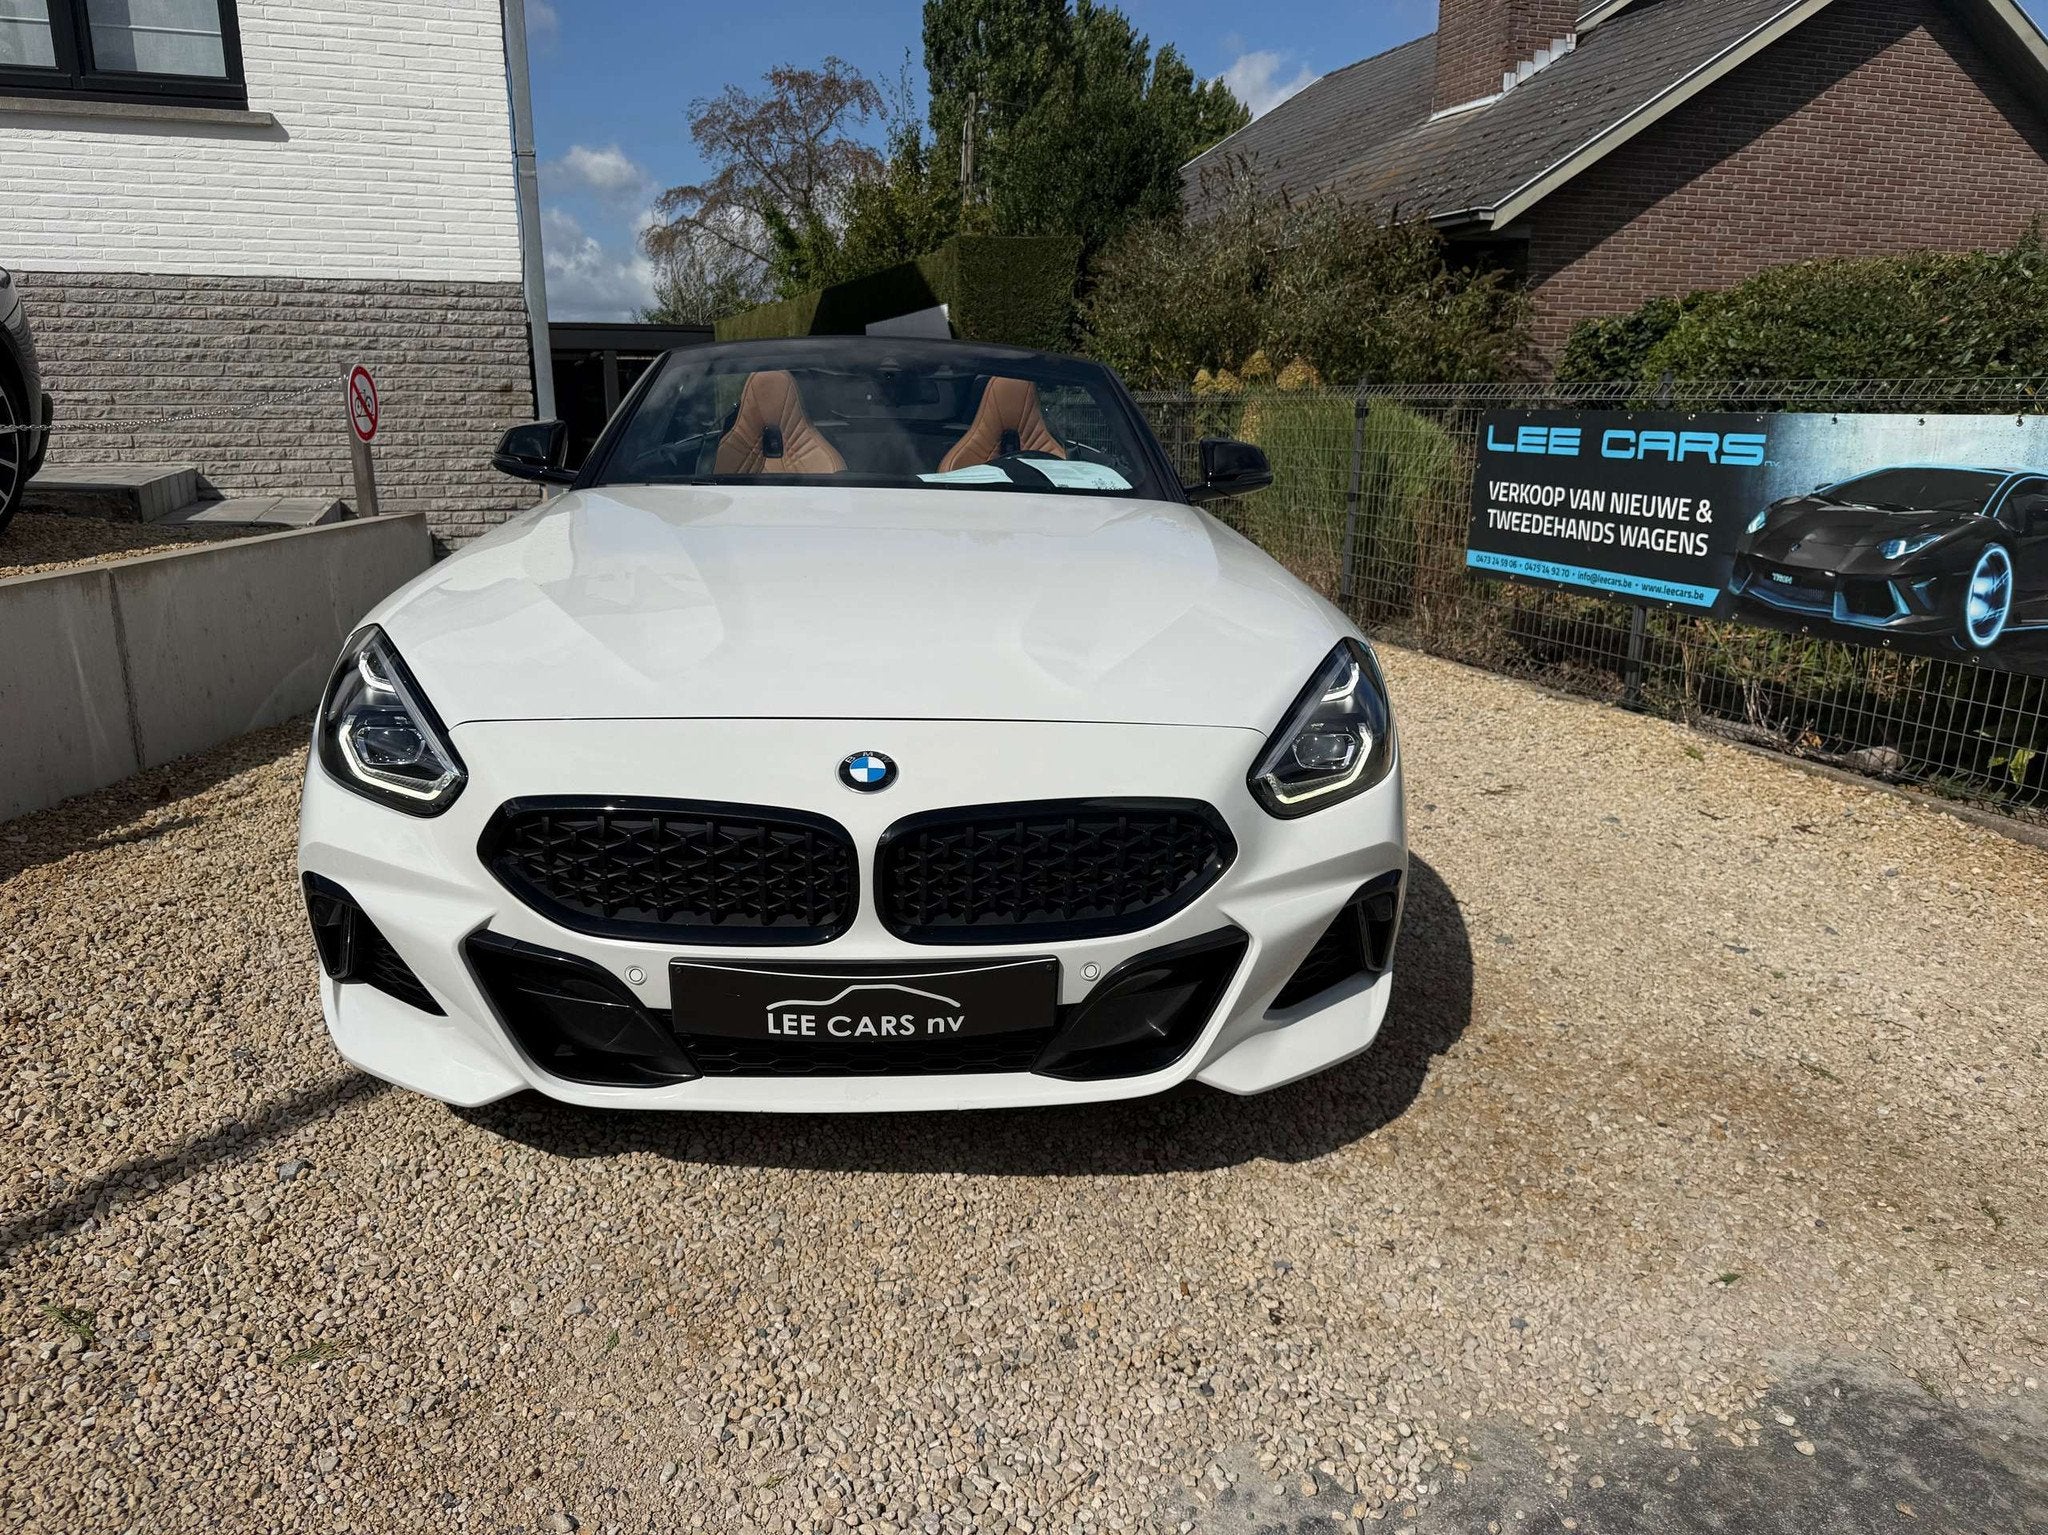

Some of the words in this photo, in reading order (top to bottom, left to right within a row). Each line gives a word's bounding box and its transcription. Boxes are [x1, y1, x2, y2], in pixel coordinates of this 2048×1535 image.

[1487, 424, 1582, 456] LEE
[1601, 429, 1767, 466] CARS
[1488, 480, 1566, 508] VERKOOP
[1569, 488, 1606, 513] VAN
[1609, 491, 1692, 522] NIEUWE
[1695, 498, 1714, 524] &
[1487, 508, 1615, 545] TWEEDEHANDS
[1619, 523, 1710, 557] WAGENS
[1475, 555, 1491, 565] 0473
[1551, 566, 1560, 577] 92
[1561, 568, 1570, 578] 70
[1577, 572, 1632, 589] info@leecars.be
[1641, 583, 1705, 601] www.leecars.be
[767, 1012, 816, 1036] LEE
[827, 1014, 916, 1037] CARS
[927, 1015, 965, 1034] nv
